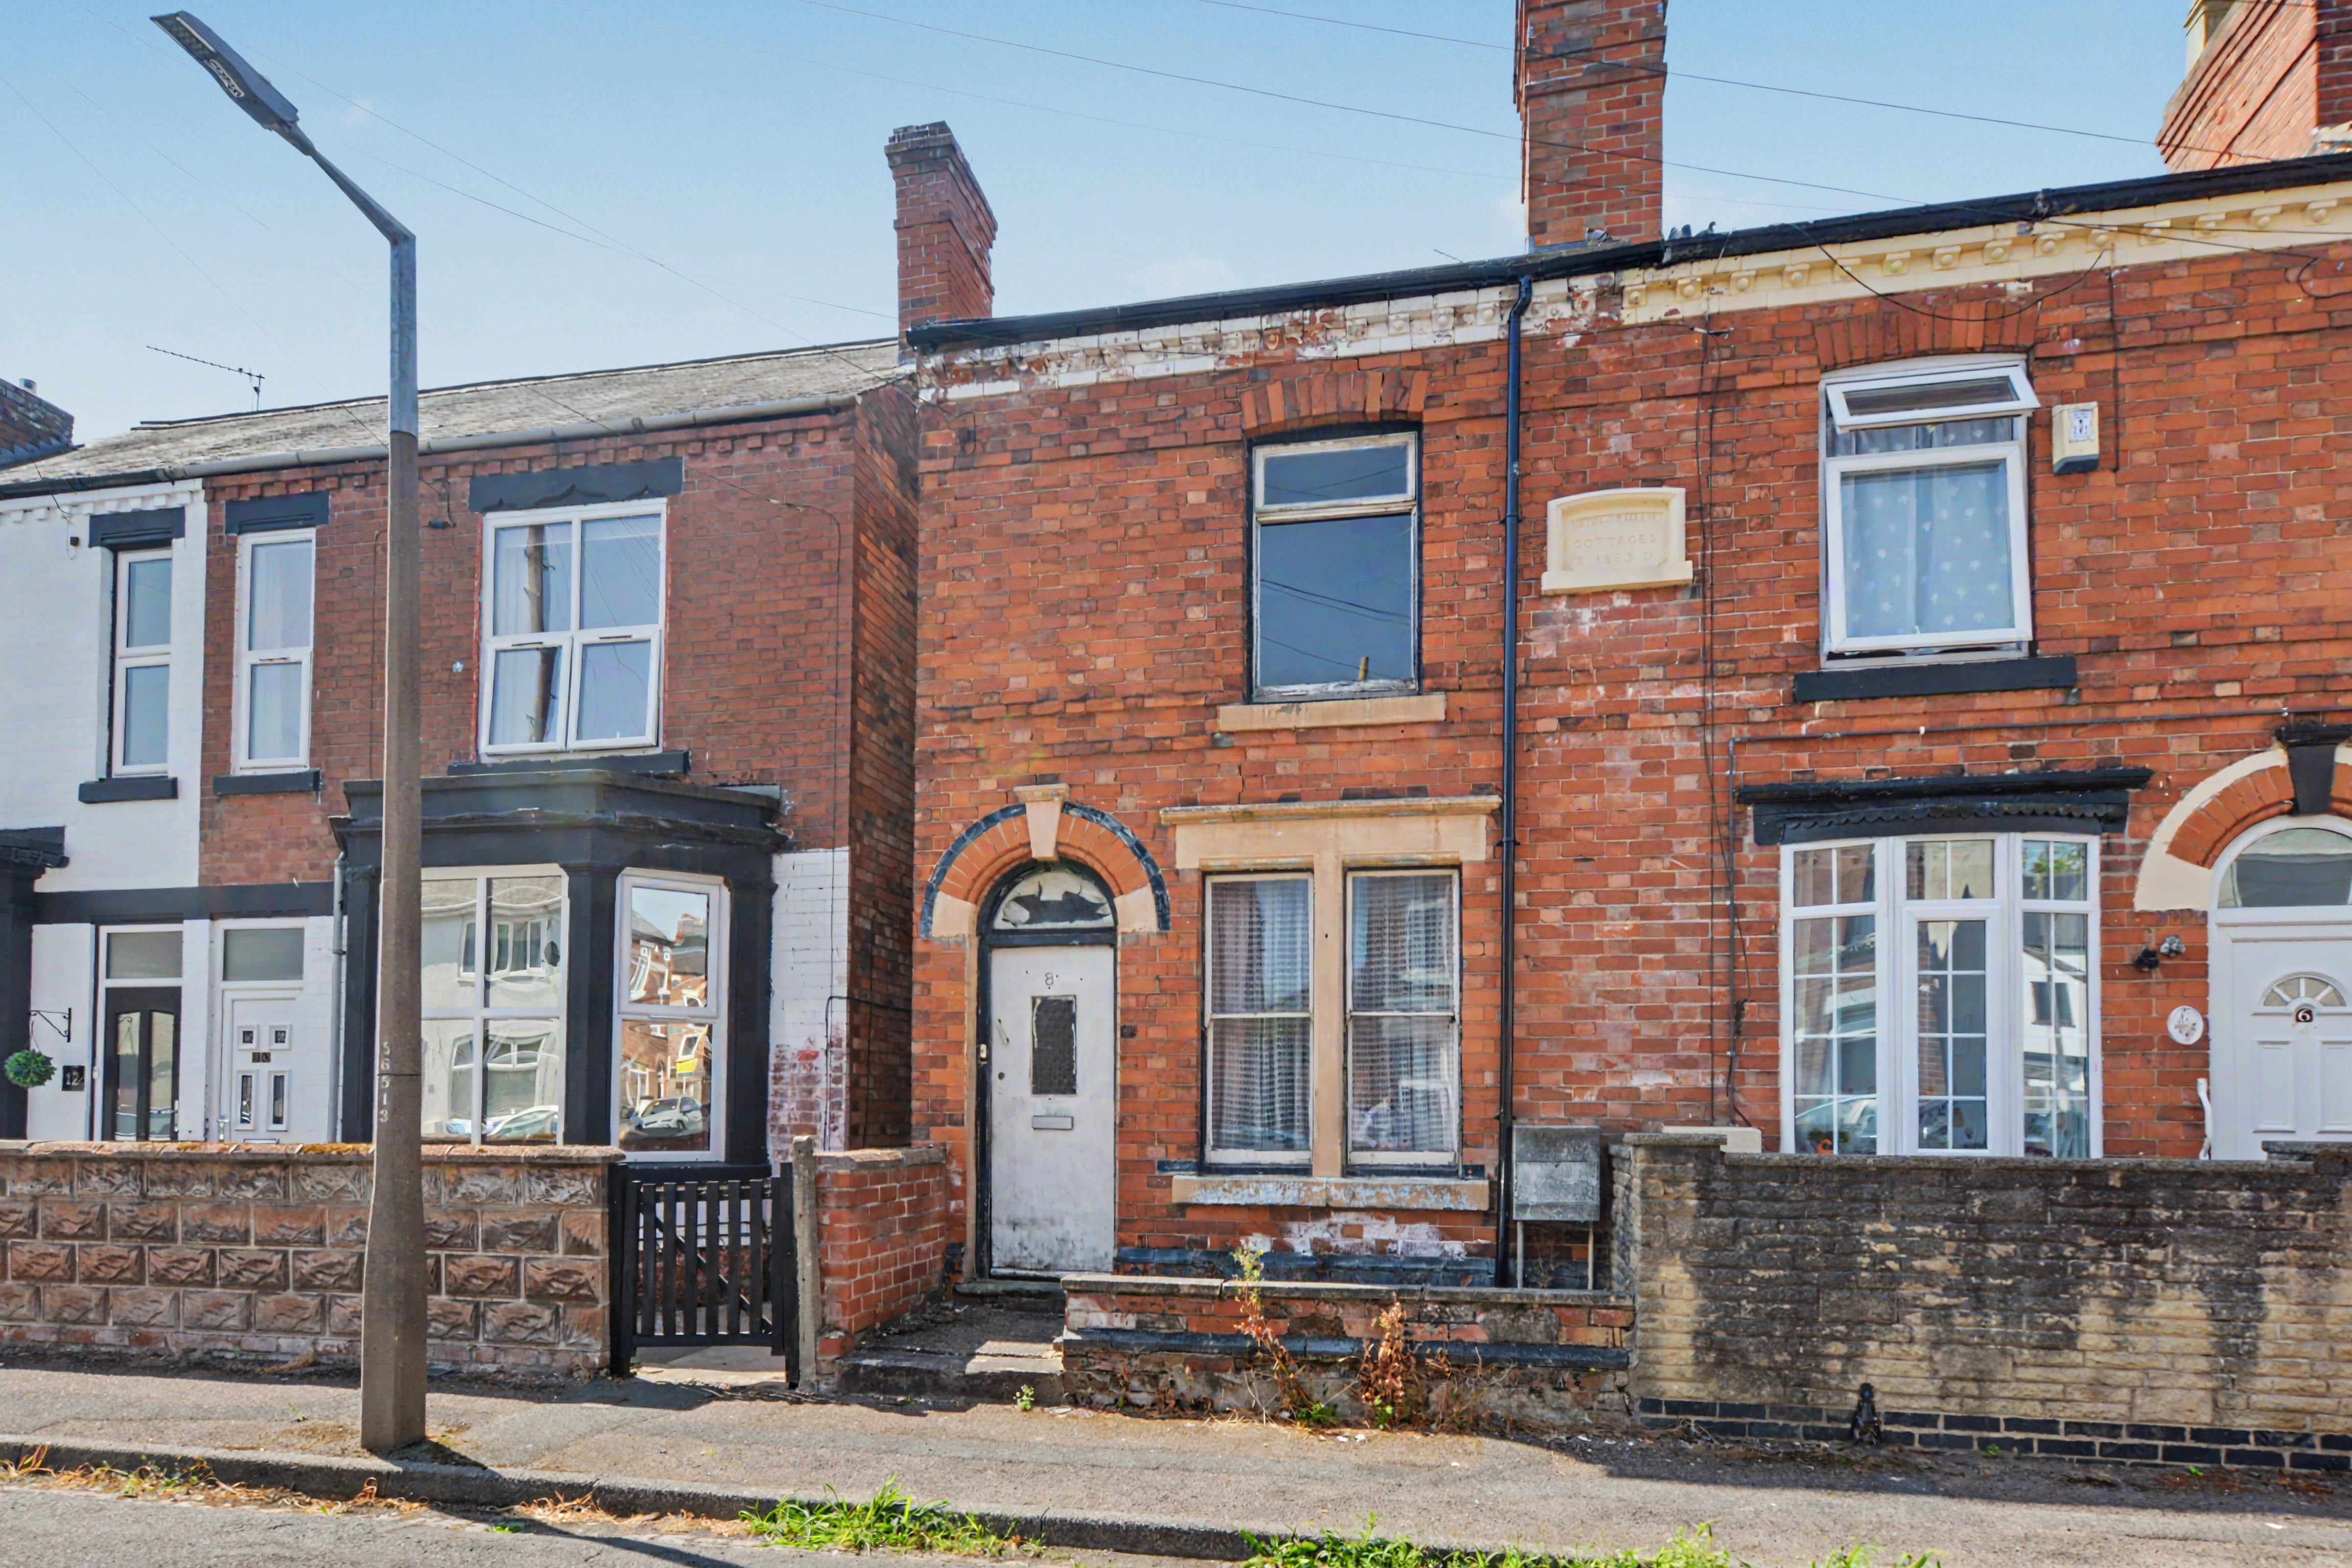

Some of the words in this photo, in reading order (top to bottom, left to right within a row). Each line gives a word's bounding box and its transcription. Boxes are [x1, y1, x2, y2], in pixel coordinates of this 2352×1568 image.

[1574, 534, 1656, 548] COTTAGES
[1045, 972, 1054, 986] 8
[2297, 1009, 2311, 1022] 6
